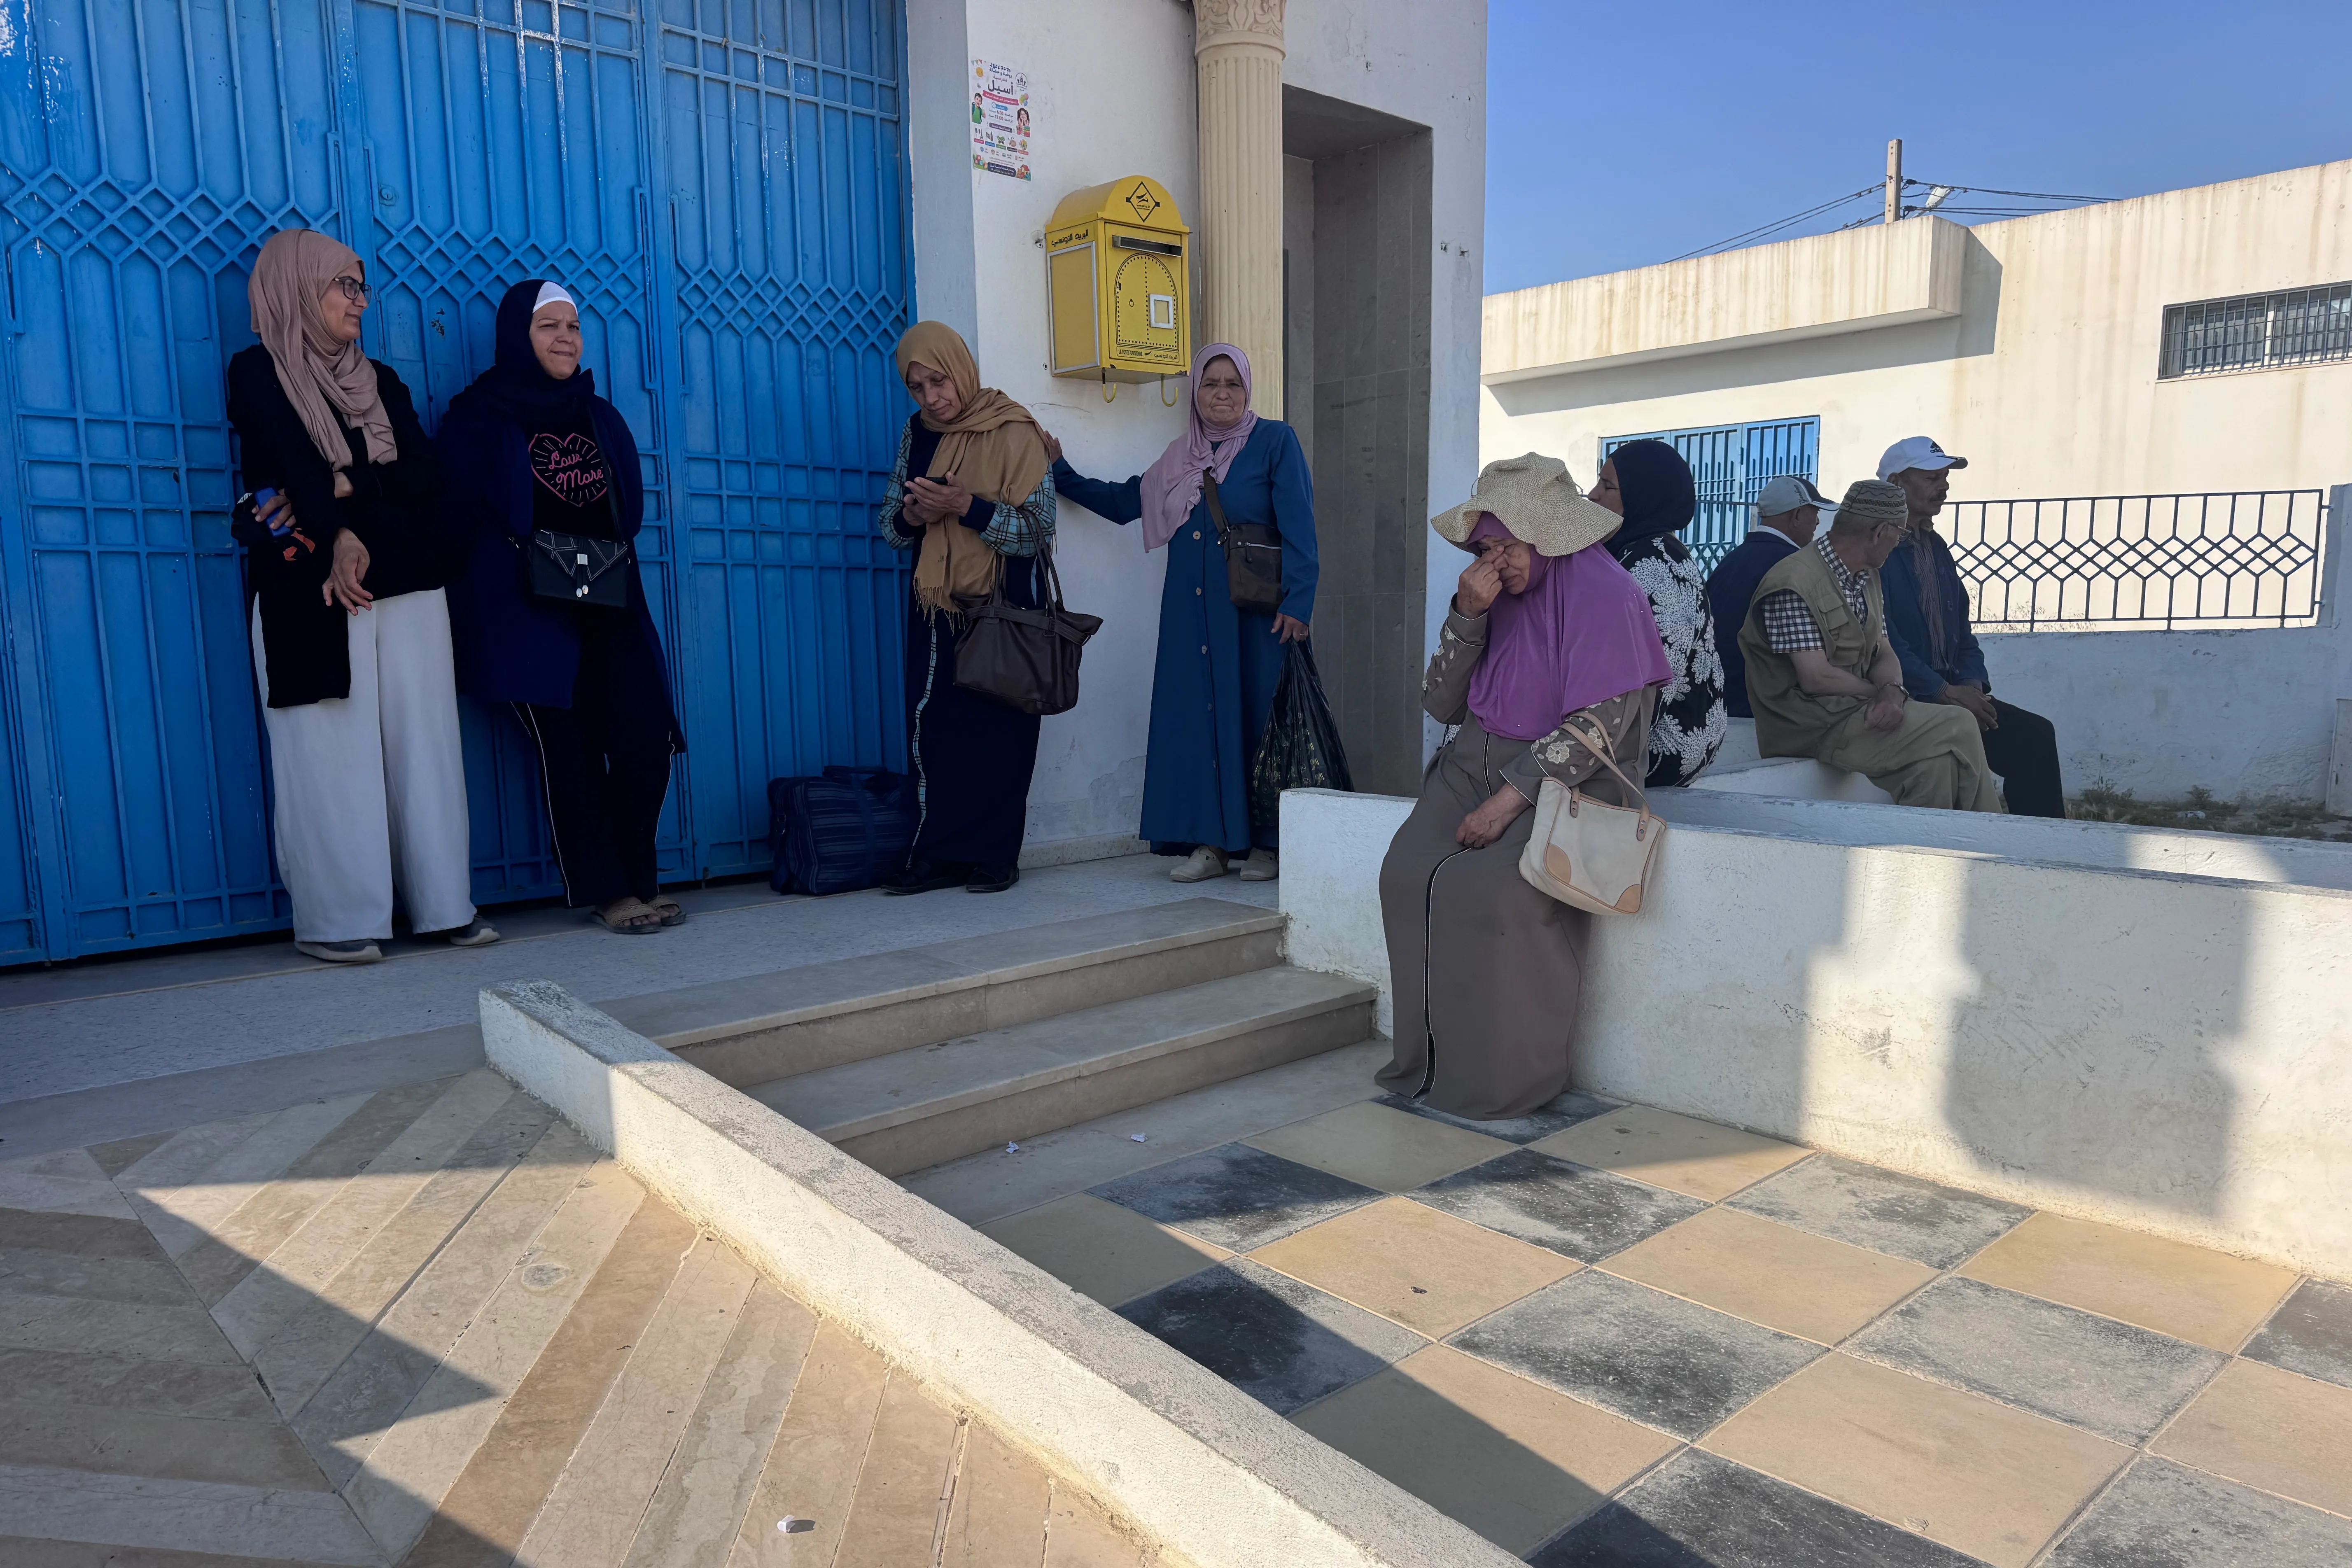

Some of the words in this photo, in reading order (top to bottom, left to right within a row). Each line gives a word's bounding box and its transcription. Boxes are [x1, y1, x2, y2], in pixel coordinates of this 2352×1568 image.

[988, 79, 1013, 95] أسيل
[1051, 233, 1073, 247] التونسي
[1075, 229, 1088, 240] البريد
[548, 451, 582, 469] Love
[556, 469, 604, 490] More
